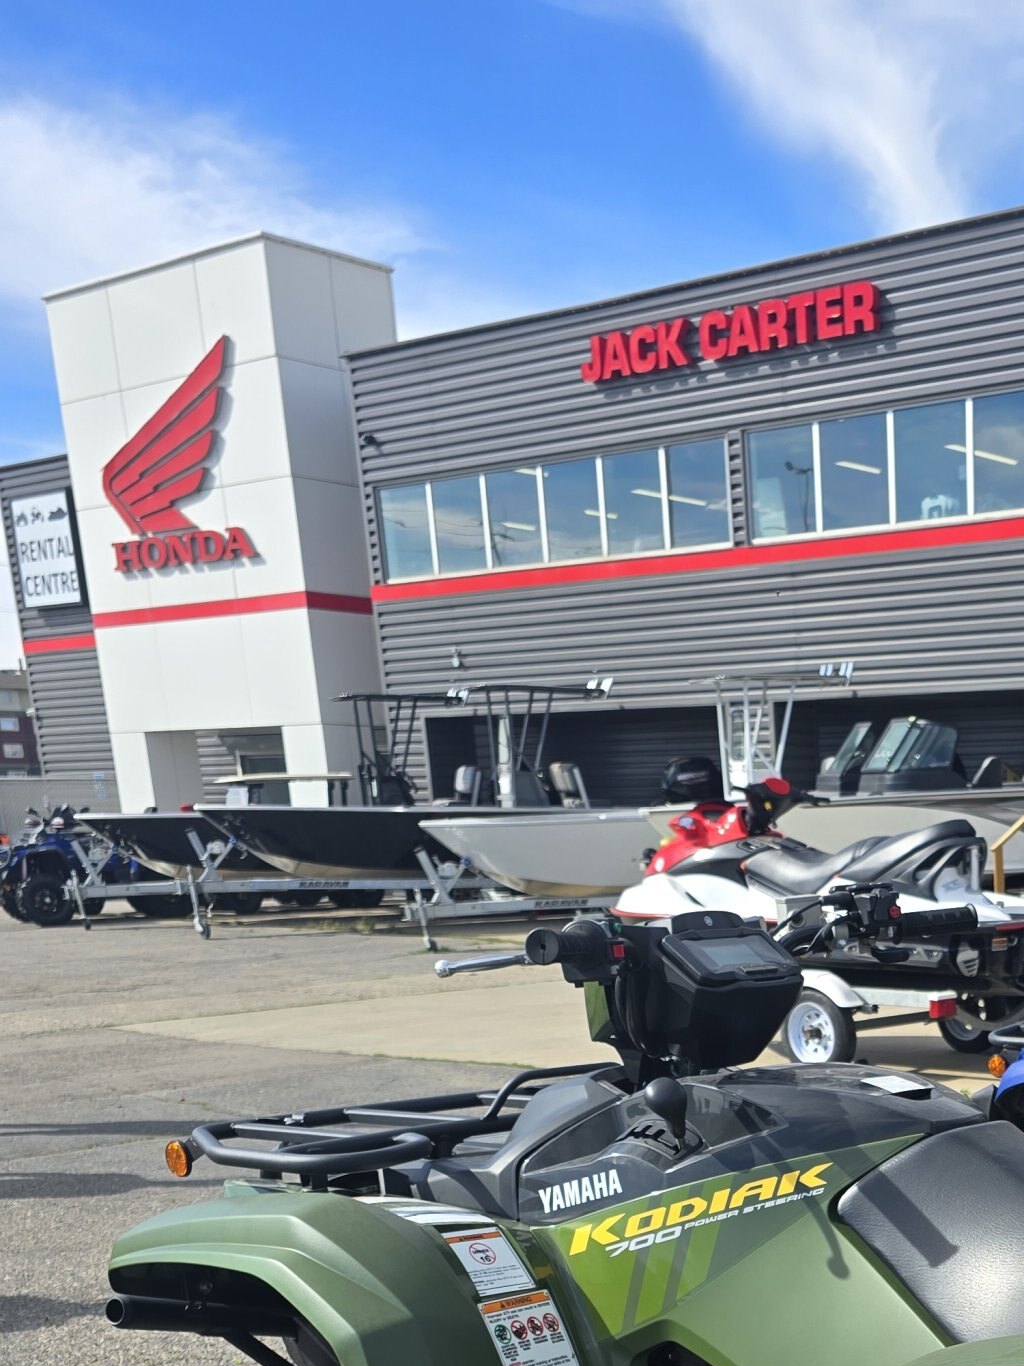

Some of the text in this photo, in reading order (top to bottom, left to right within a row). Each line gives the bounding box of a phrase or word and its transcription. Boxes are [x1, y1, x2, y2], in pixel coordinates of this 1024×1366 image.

[580, 280, 880, 383] JACK CARTER
[20, 536, 75, 563] RENTAL
[111, 527, 258, 572] HONDA
[25, 571, 80, 597] CENTRE
[538, 1169, 623, 1214] YAMAHA
[569, 1162, 834, 1256] KODIAK
[604, 1187, 825, 1258] 700 POWER STEERING
[480, 1254, 492, 1263] 16
